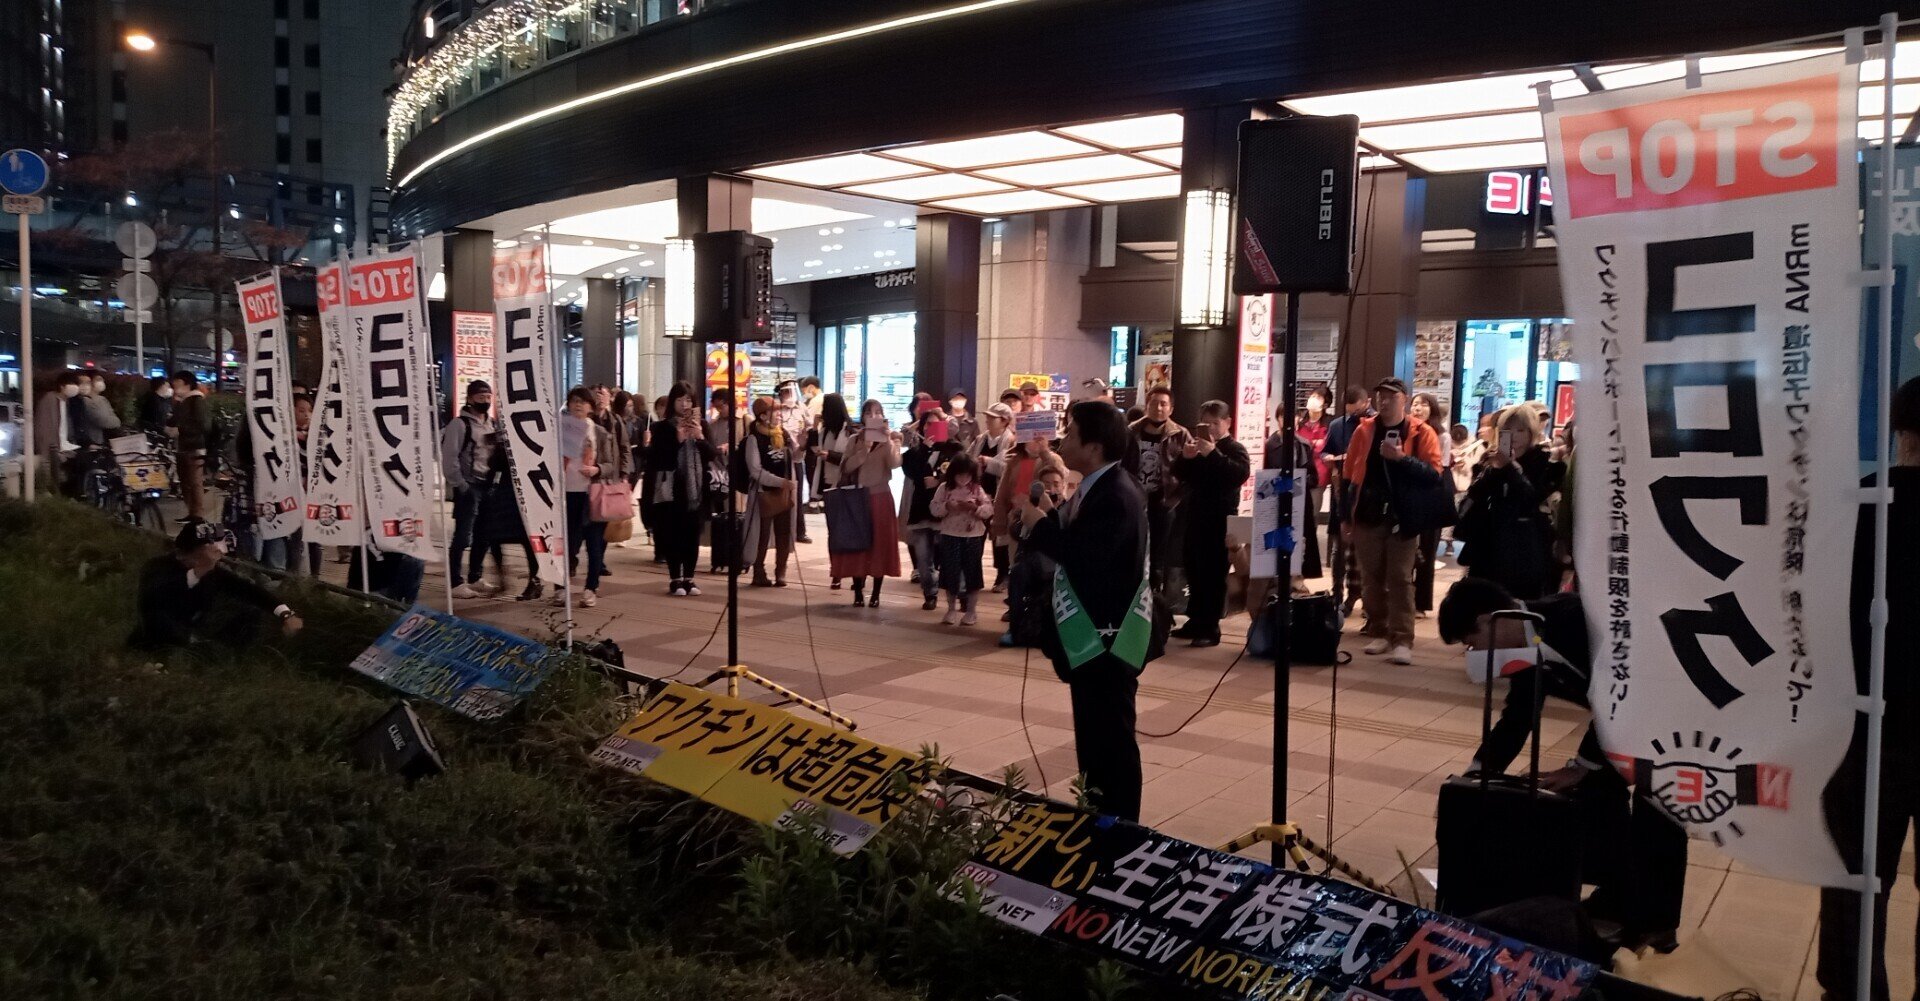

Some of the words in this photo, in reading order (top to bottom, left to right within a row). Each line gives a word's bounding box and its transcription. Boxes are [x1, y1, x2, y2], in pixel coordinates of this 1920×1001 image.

[1318, 168, 1334, 240] CUBE
[706, 350, 752, 387] 20
[628, 693, 930, 824] ワクチンは超危険
[1051, 904, 1110, 940] NO
[1098, 918, 1192, 964] NEW
